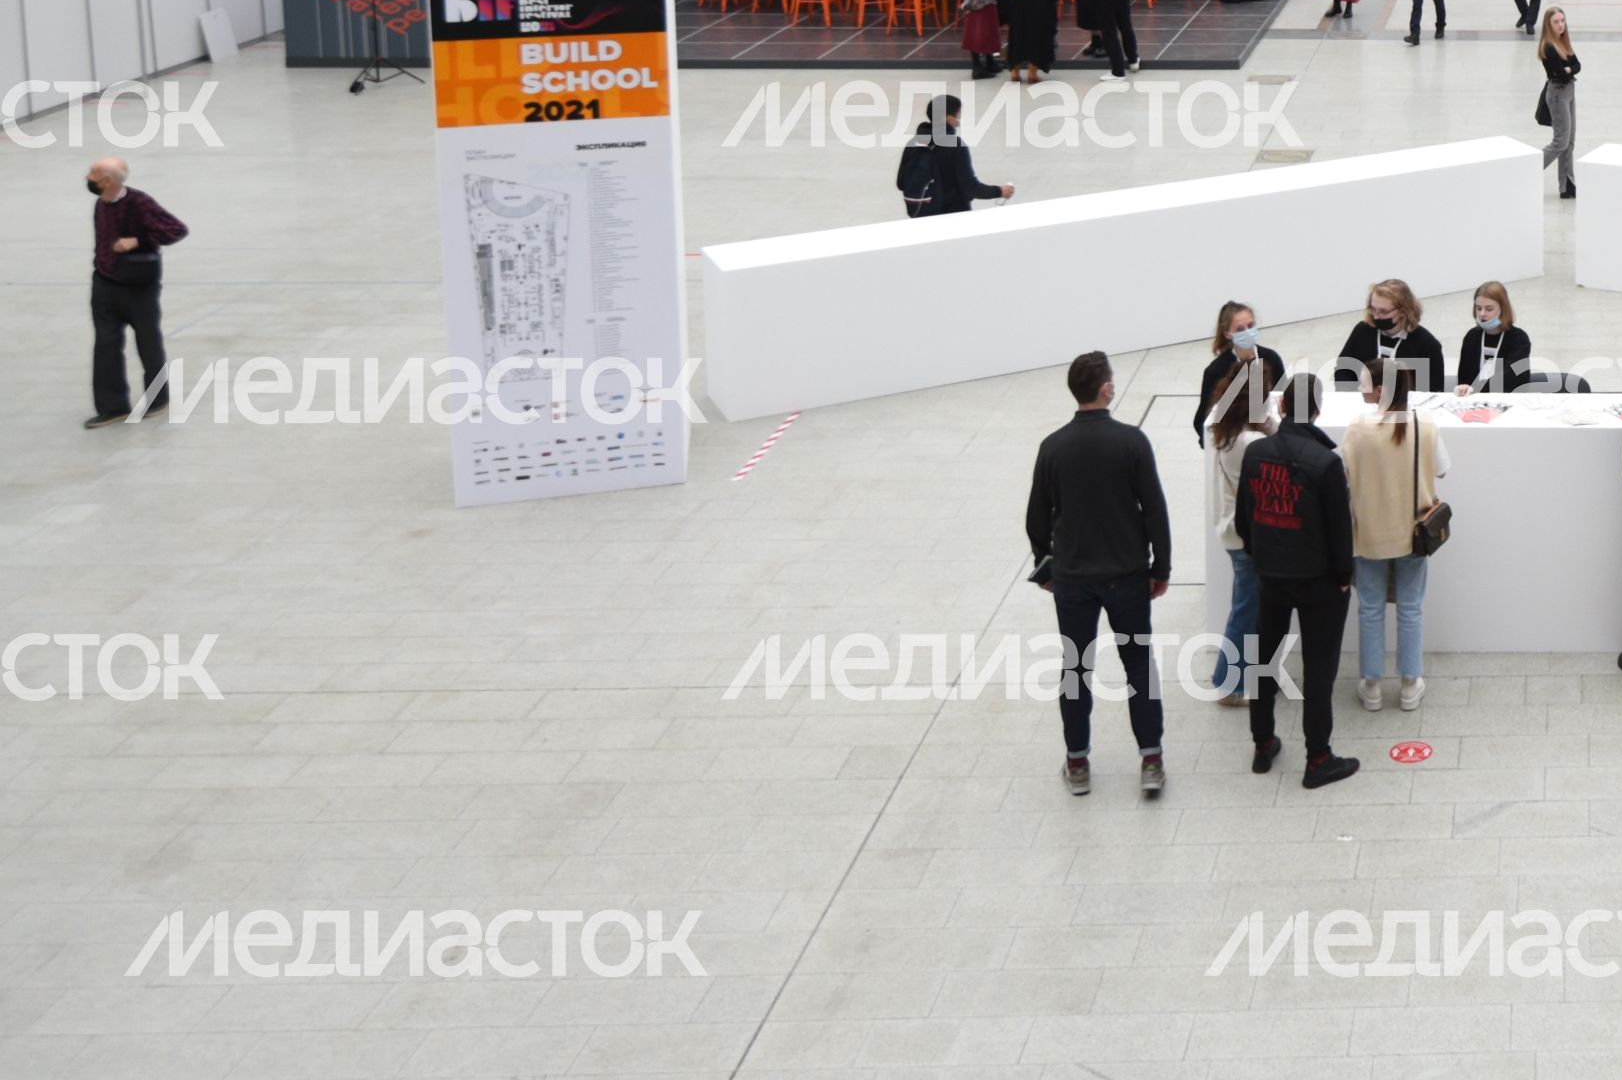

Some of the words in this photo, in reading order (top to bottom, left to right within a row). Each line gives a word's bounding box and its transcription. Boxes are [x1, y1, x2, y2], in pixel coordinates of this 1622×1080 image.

[521, 40, 622, 65] BUILD
[521, 67, 658, 94] SCHOOL
[523, 99, 601, 123] 2021
[1260, 461, 1290, 482] THE
[1249, 477, 1303, 500] MONEY
